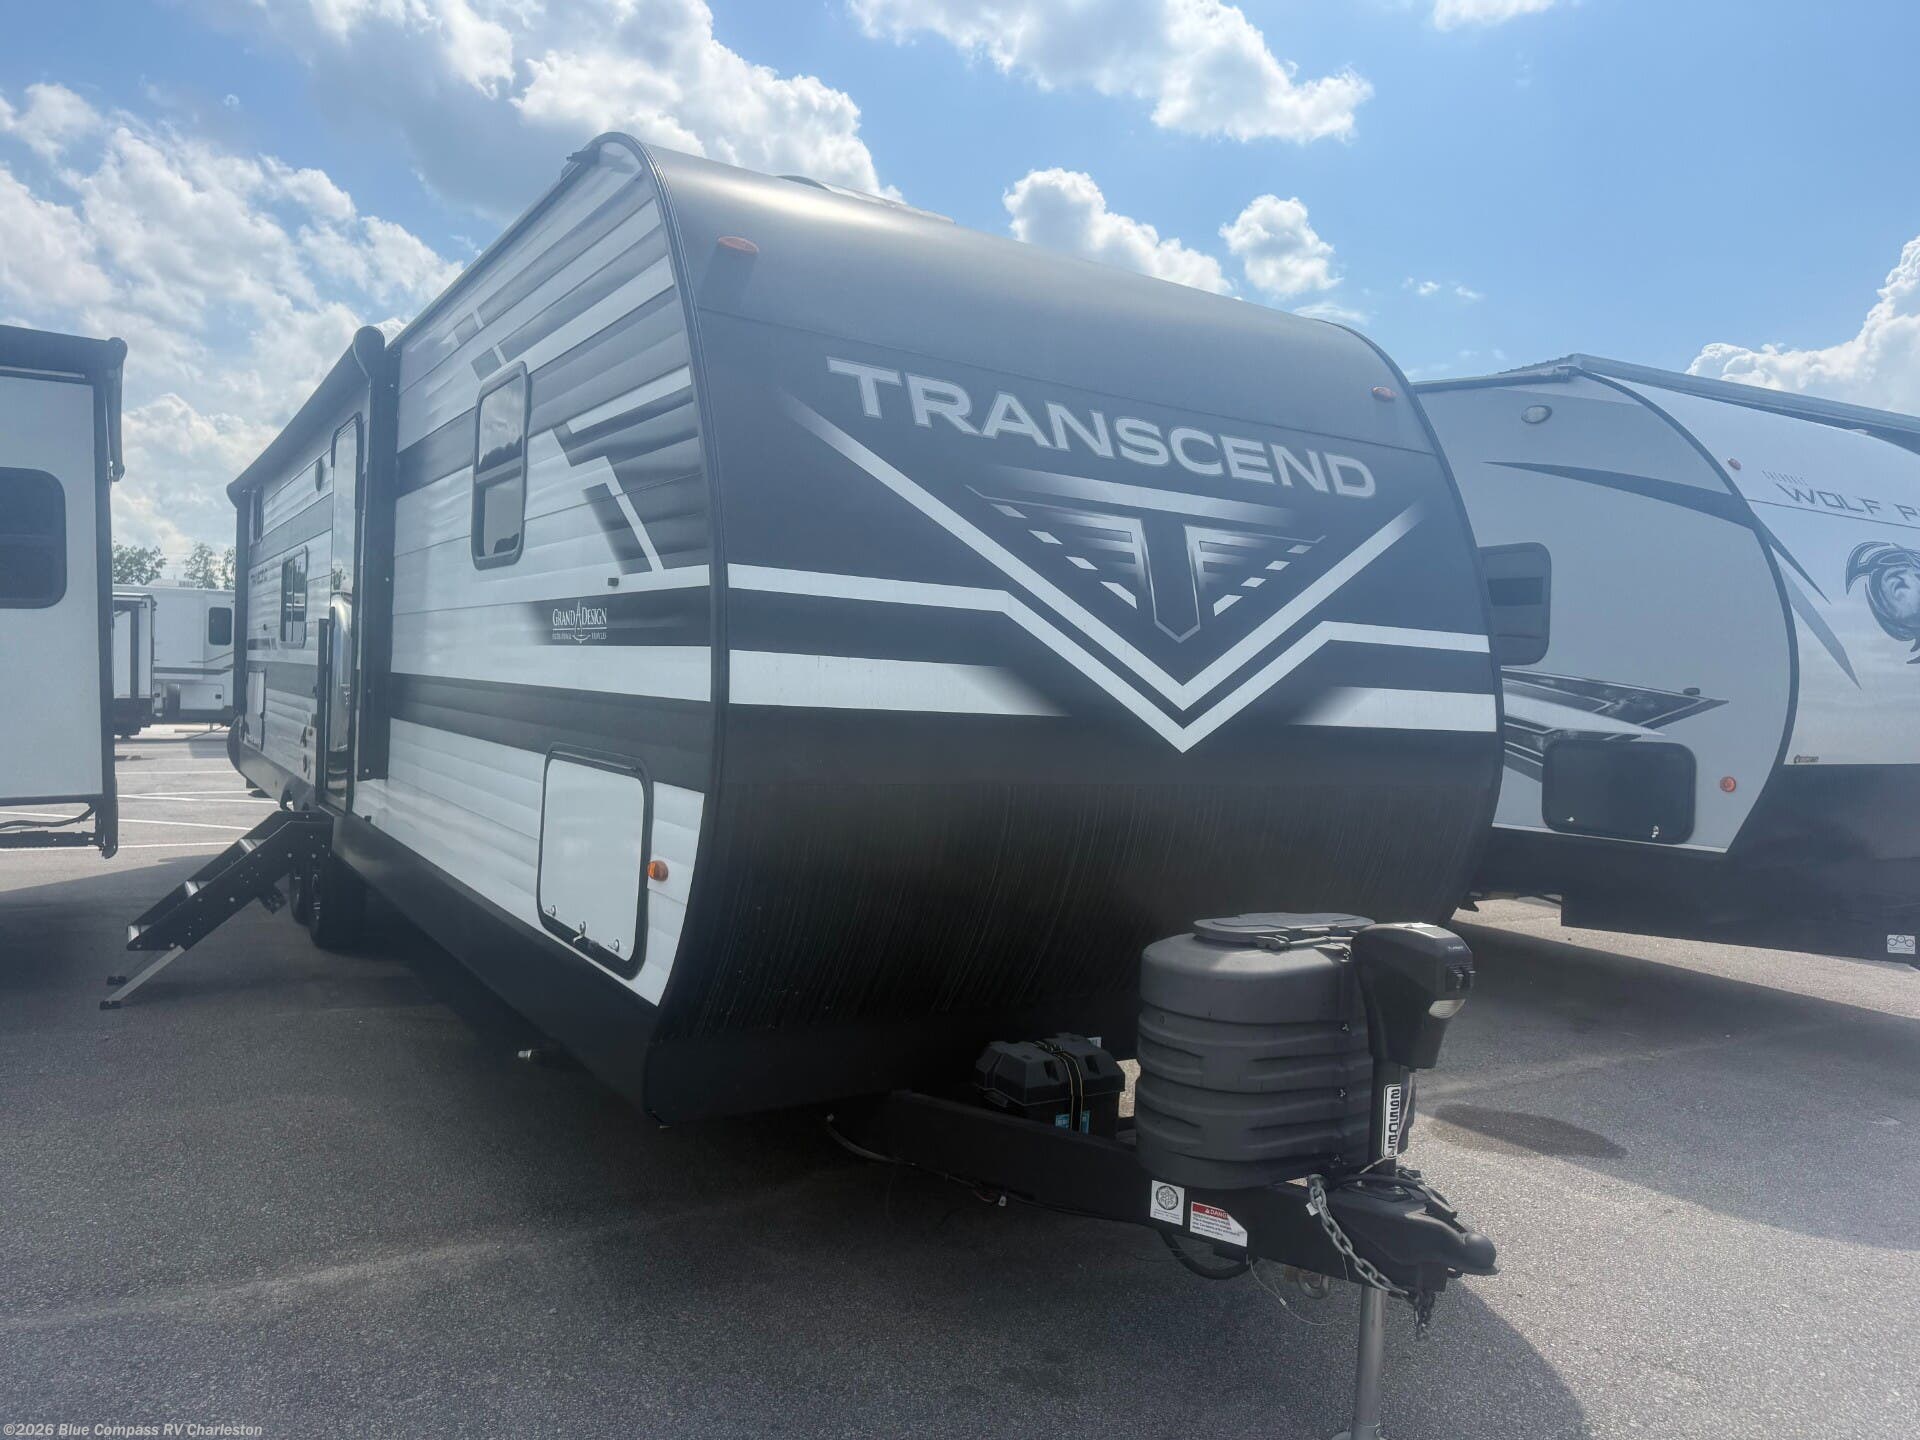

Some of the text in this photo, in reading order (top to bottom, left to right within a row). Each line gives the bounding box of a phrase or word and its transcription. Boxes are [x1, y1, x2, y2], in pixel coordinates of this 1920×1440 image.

[826, 356, 1376, 498] TRANSCEND
[1776, 483, 1881, 514] WOLF
[553, 606, 607, 626] GRAND DESIGN
[1210, 1208, 1228, 1220] DANG
